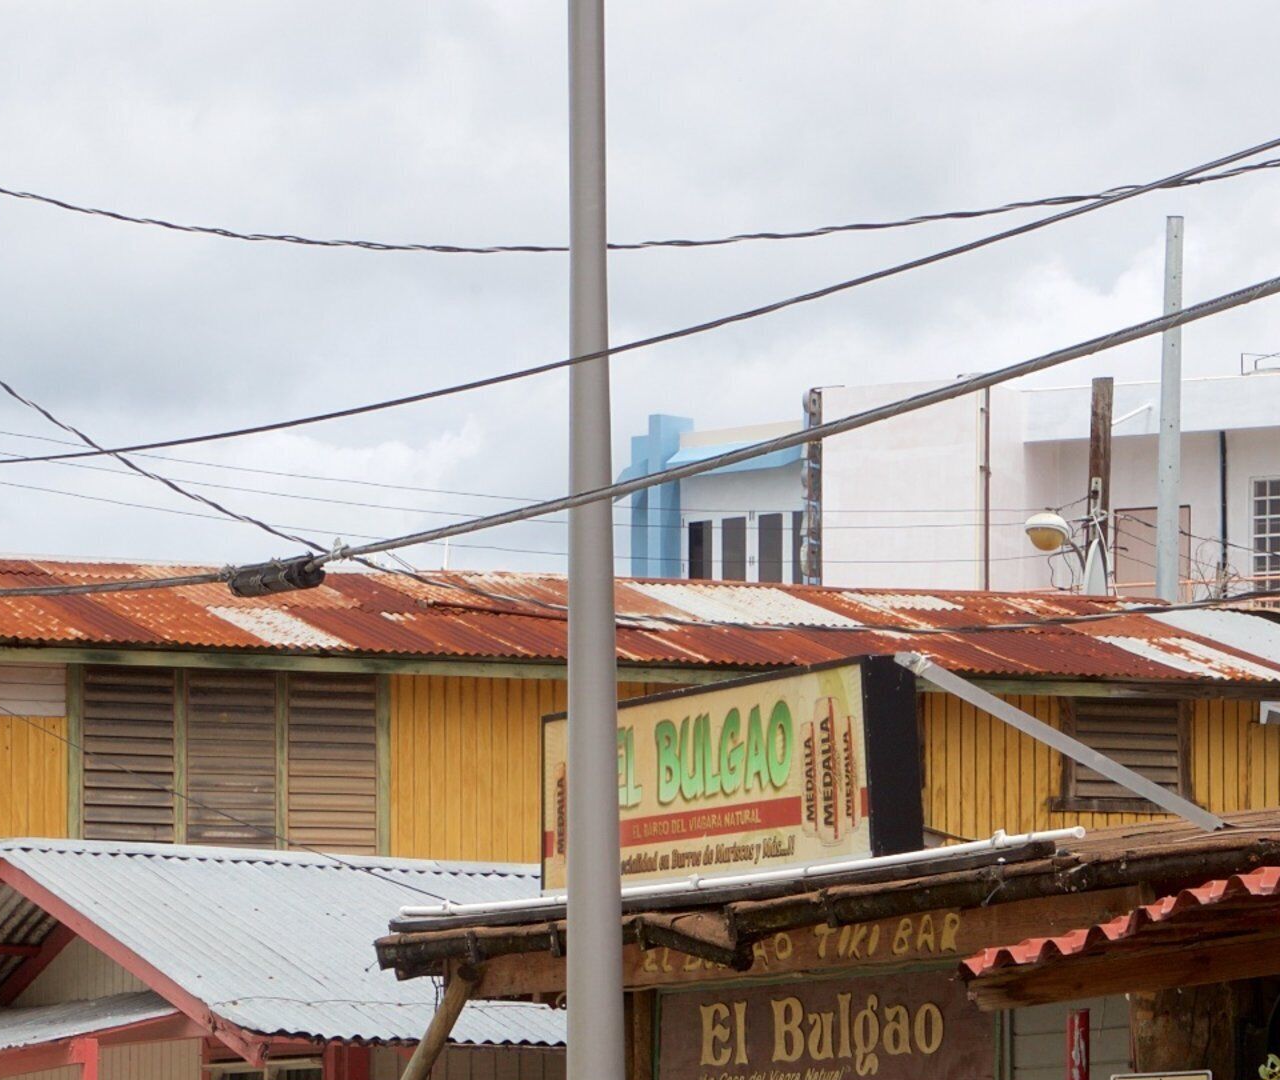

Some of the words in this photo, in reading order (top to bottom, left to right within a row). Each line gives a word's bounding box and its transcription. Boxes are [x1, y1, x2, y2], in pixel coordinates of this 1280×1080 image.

[654, 698, 794, 807] BULGAO
[805, 736, 816, 823] MEDALLA
[820, 715, 833, 827] MEDALLA
[842, 731, 852, 818] MEDALLA
[671, 818, 687, 833] DEL
[724, 807, 762, 828] NATURAL
[671, 848, 701, 869] Burros
[702, 844, 714, 865] de
[715, 841, 754, 864] Mariscos
[815, 924, 881, 959] TIKI
[891, 911, 961, 957] BAR
[698, 1000, 751, 1067] El
[770, 991, 945, 1078] Bulgao
